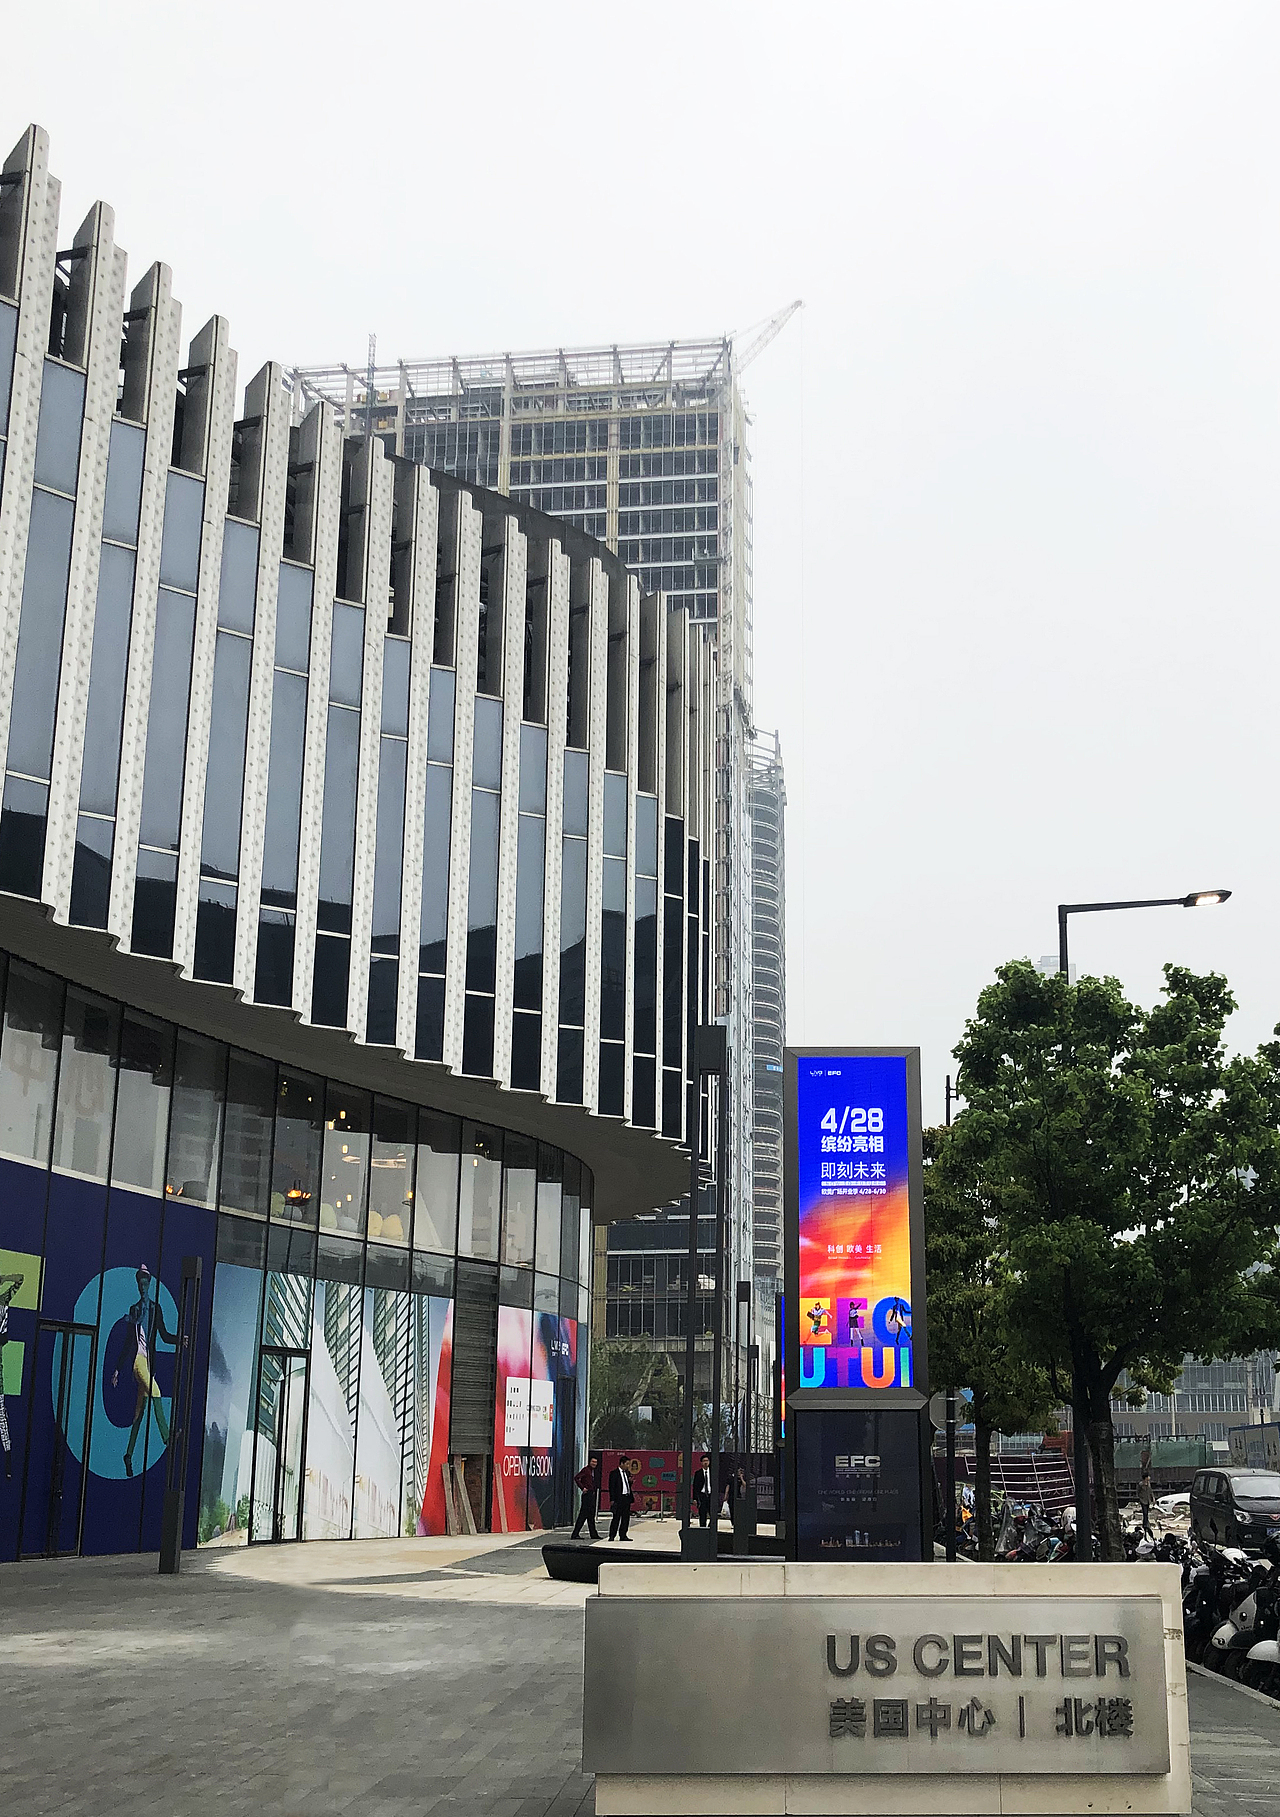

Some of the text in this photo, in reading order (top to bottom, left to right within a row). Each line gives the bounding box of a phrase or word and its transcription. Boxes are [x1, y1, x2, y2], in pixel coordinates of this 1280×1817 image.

[820, 1106, 884, 1134] 4/28
[820, 1135, 884, 1153] 缤纷亮相
[821, 1161, 887, 1180] 即刻未来
[827, 1244, 844, 1254] 科创
[865, 1244, 882, 1254] 生活
[537, 1456, 553, 1476] SOON
[835, 1456, 881, 1467] EFC
[826, 1634, 1131, 1677] US CENTER
[828, 1696, 997, 1738] 美国中心
[1055, 1696, 1134, 1738] 北楼
